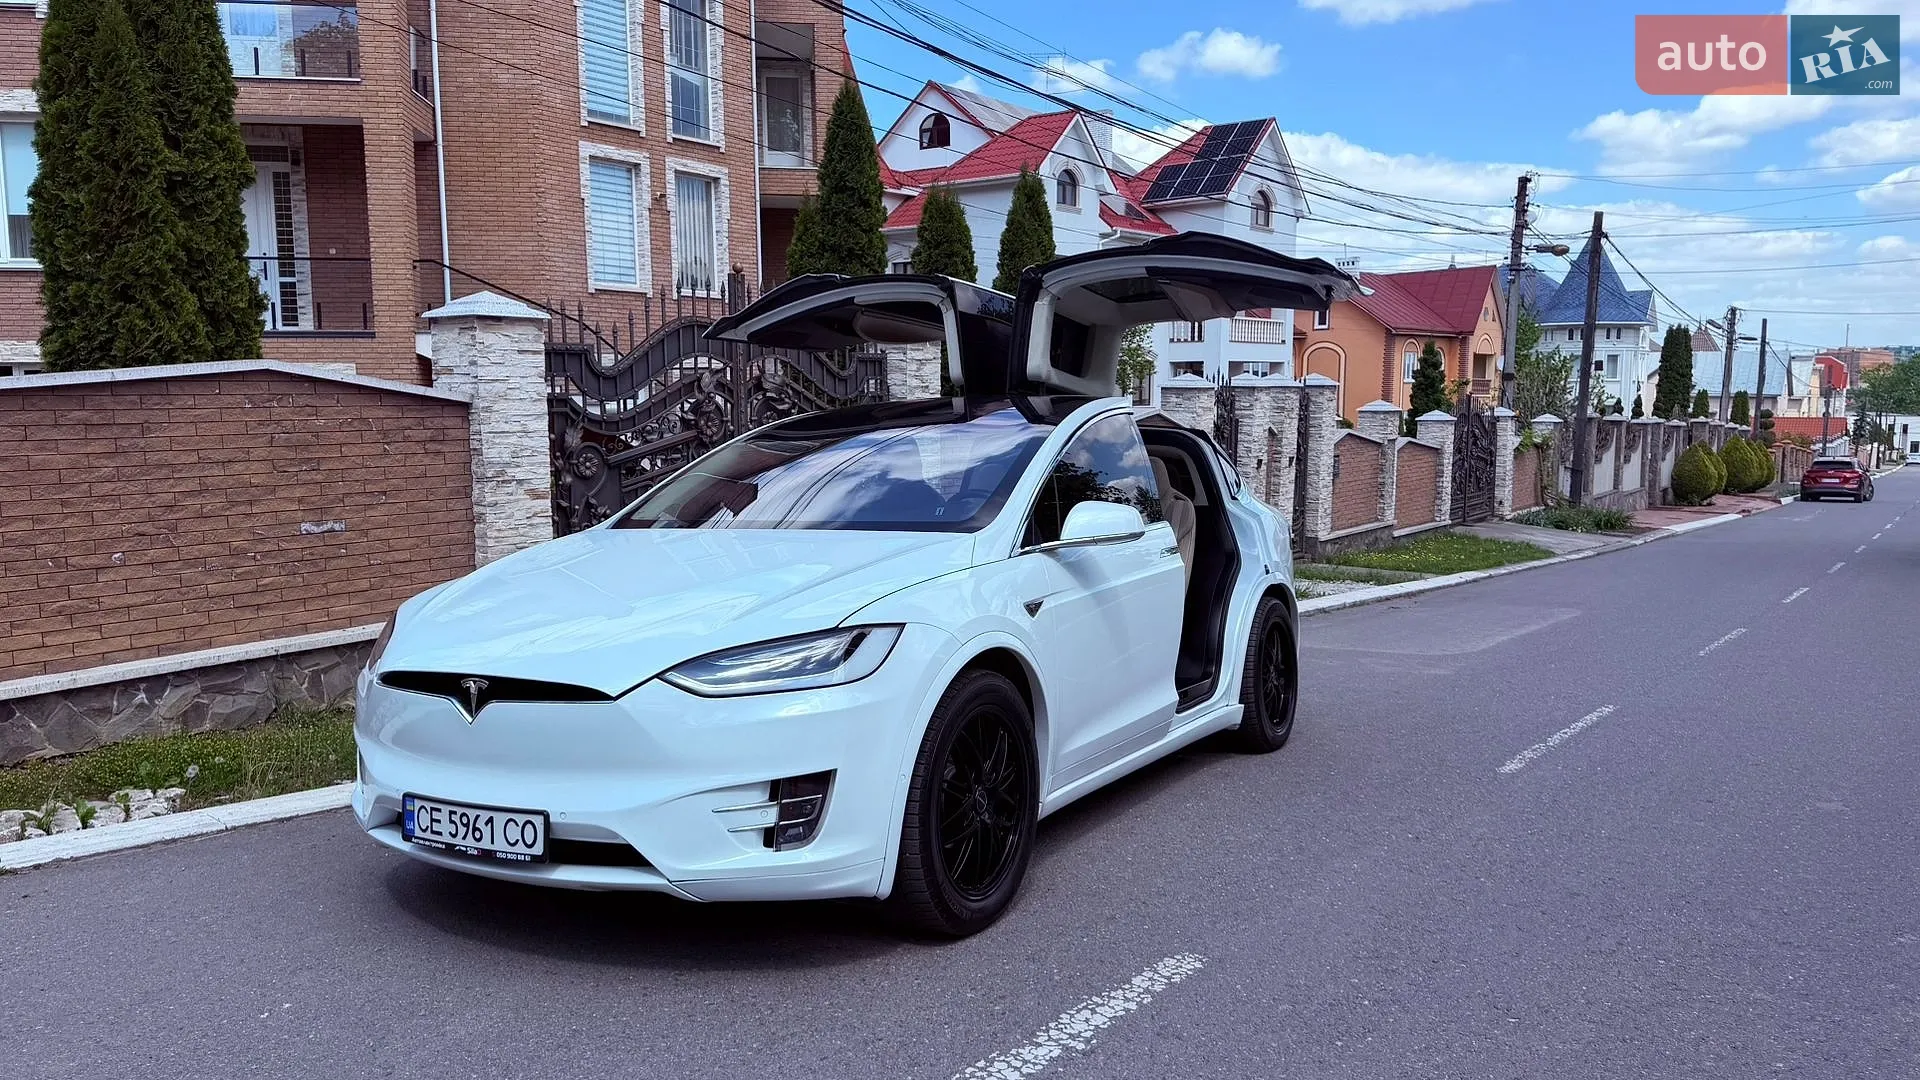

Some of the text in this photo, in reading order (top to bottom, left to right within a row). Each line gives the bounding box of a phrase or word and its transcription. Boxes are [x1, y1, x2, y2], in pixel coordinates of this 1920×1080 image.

[405, 820, 414, 830] UA
[417, 805, 538, 849] CE 5961 CO
